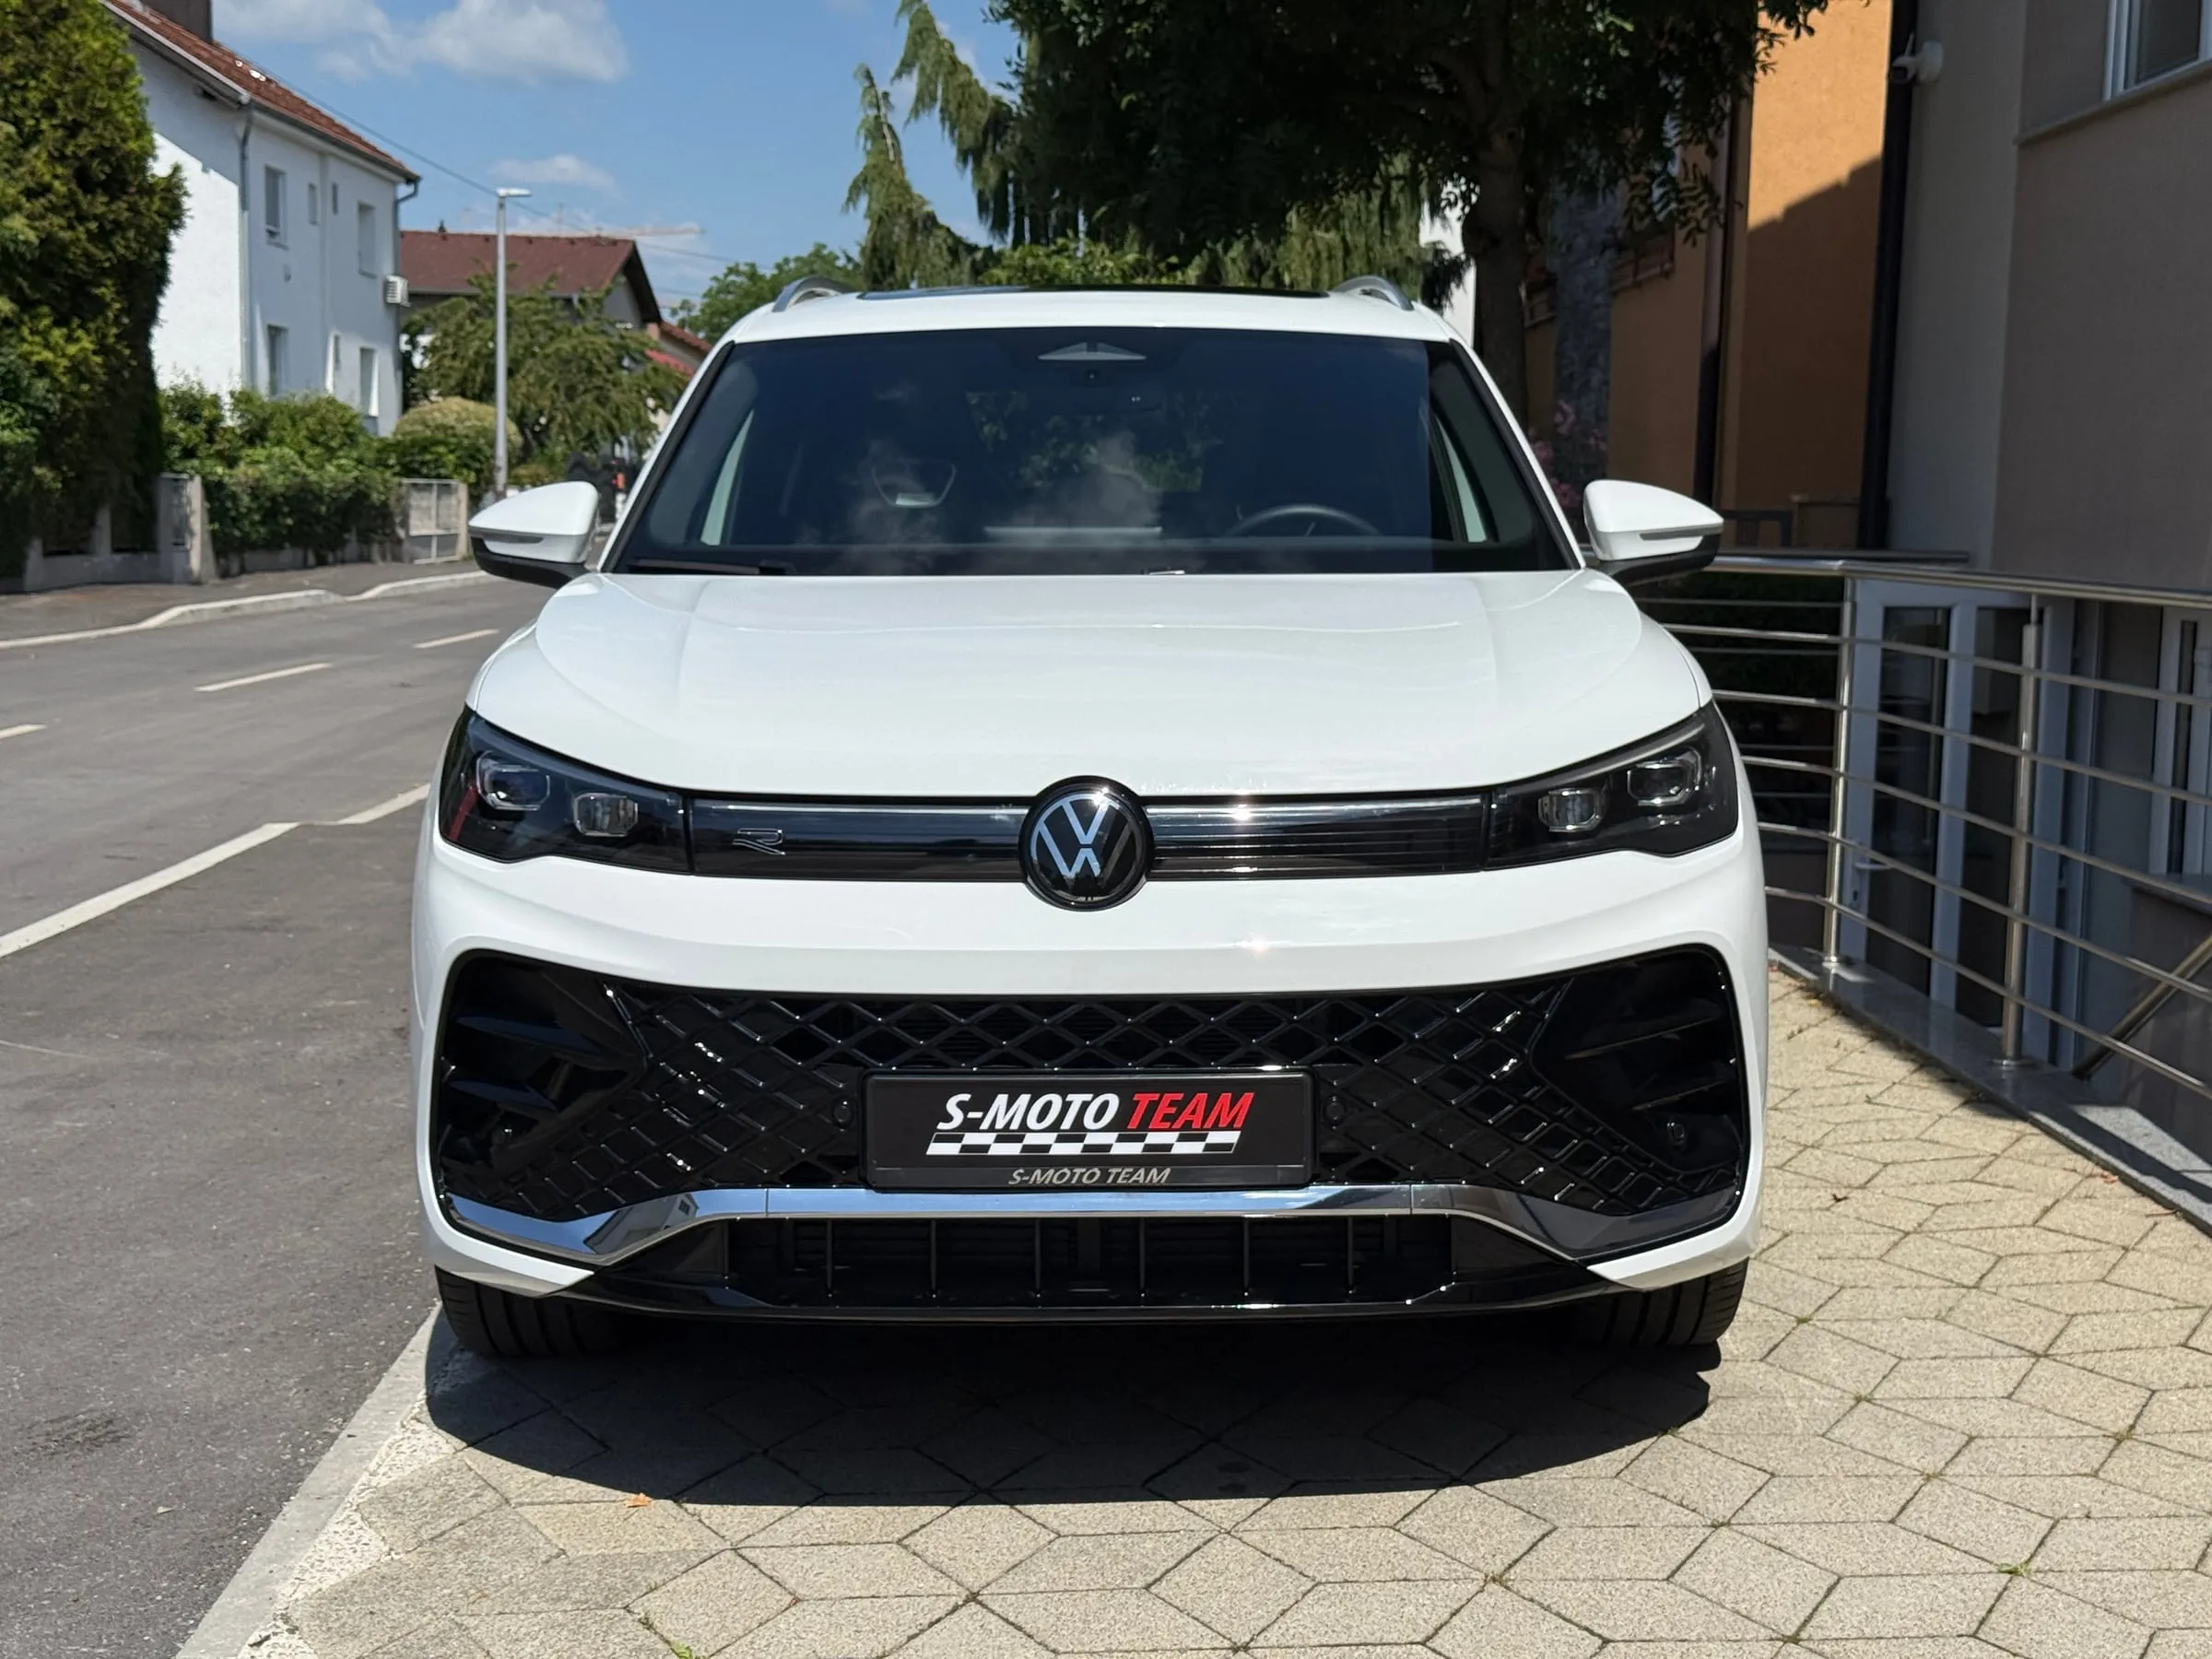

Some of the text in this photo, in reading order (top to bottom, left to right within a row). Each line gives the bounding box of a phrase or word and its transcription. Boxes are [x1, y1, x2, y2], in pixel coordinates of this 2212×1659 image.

[1032, 794, 1141, 896] VW
[936, 1092, 1254, 1131] S-MOTO TEAM
[1008, 1167, 1171, 1186] S-MOTO TEAM
